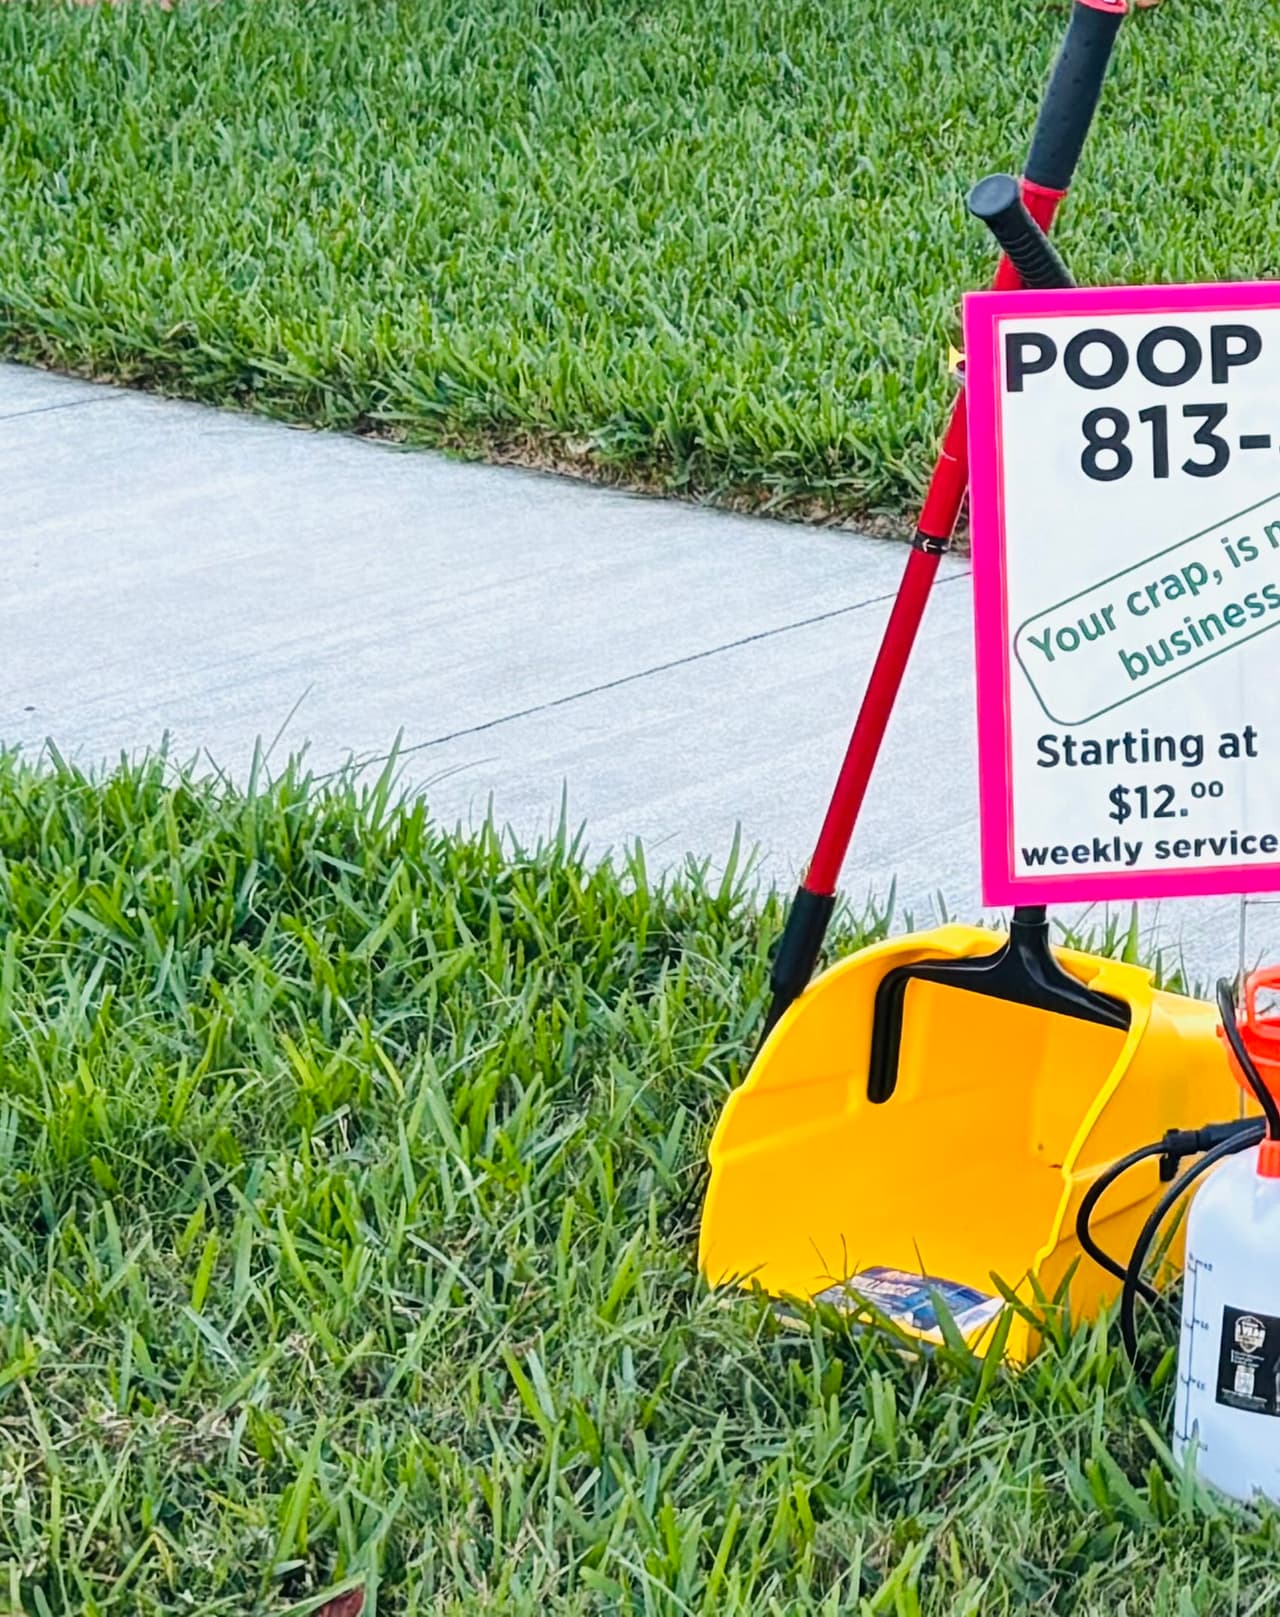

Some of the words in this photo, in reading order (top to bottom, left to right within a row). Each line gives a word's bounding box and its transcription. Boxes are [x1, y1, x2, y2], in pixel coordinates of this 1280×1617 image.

[1006, 323, 1263, 393] POOP
[1026, 605, 1118, 665] Your
[1126, 559, 1224, 619] crap,
[1219, 535, 1261, 571] is
[1036, 729, 1204, 770] Starting
[1217, 726, 1258, 759] at
[1021, 833, 1142, 867] weekly
[1155, 830, 1279, 858] service
